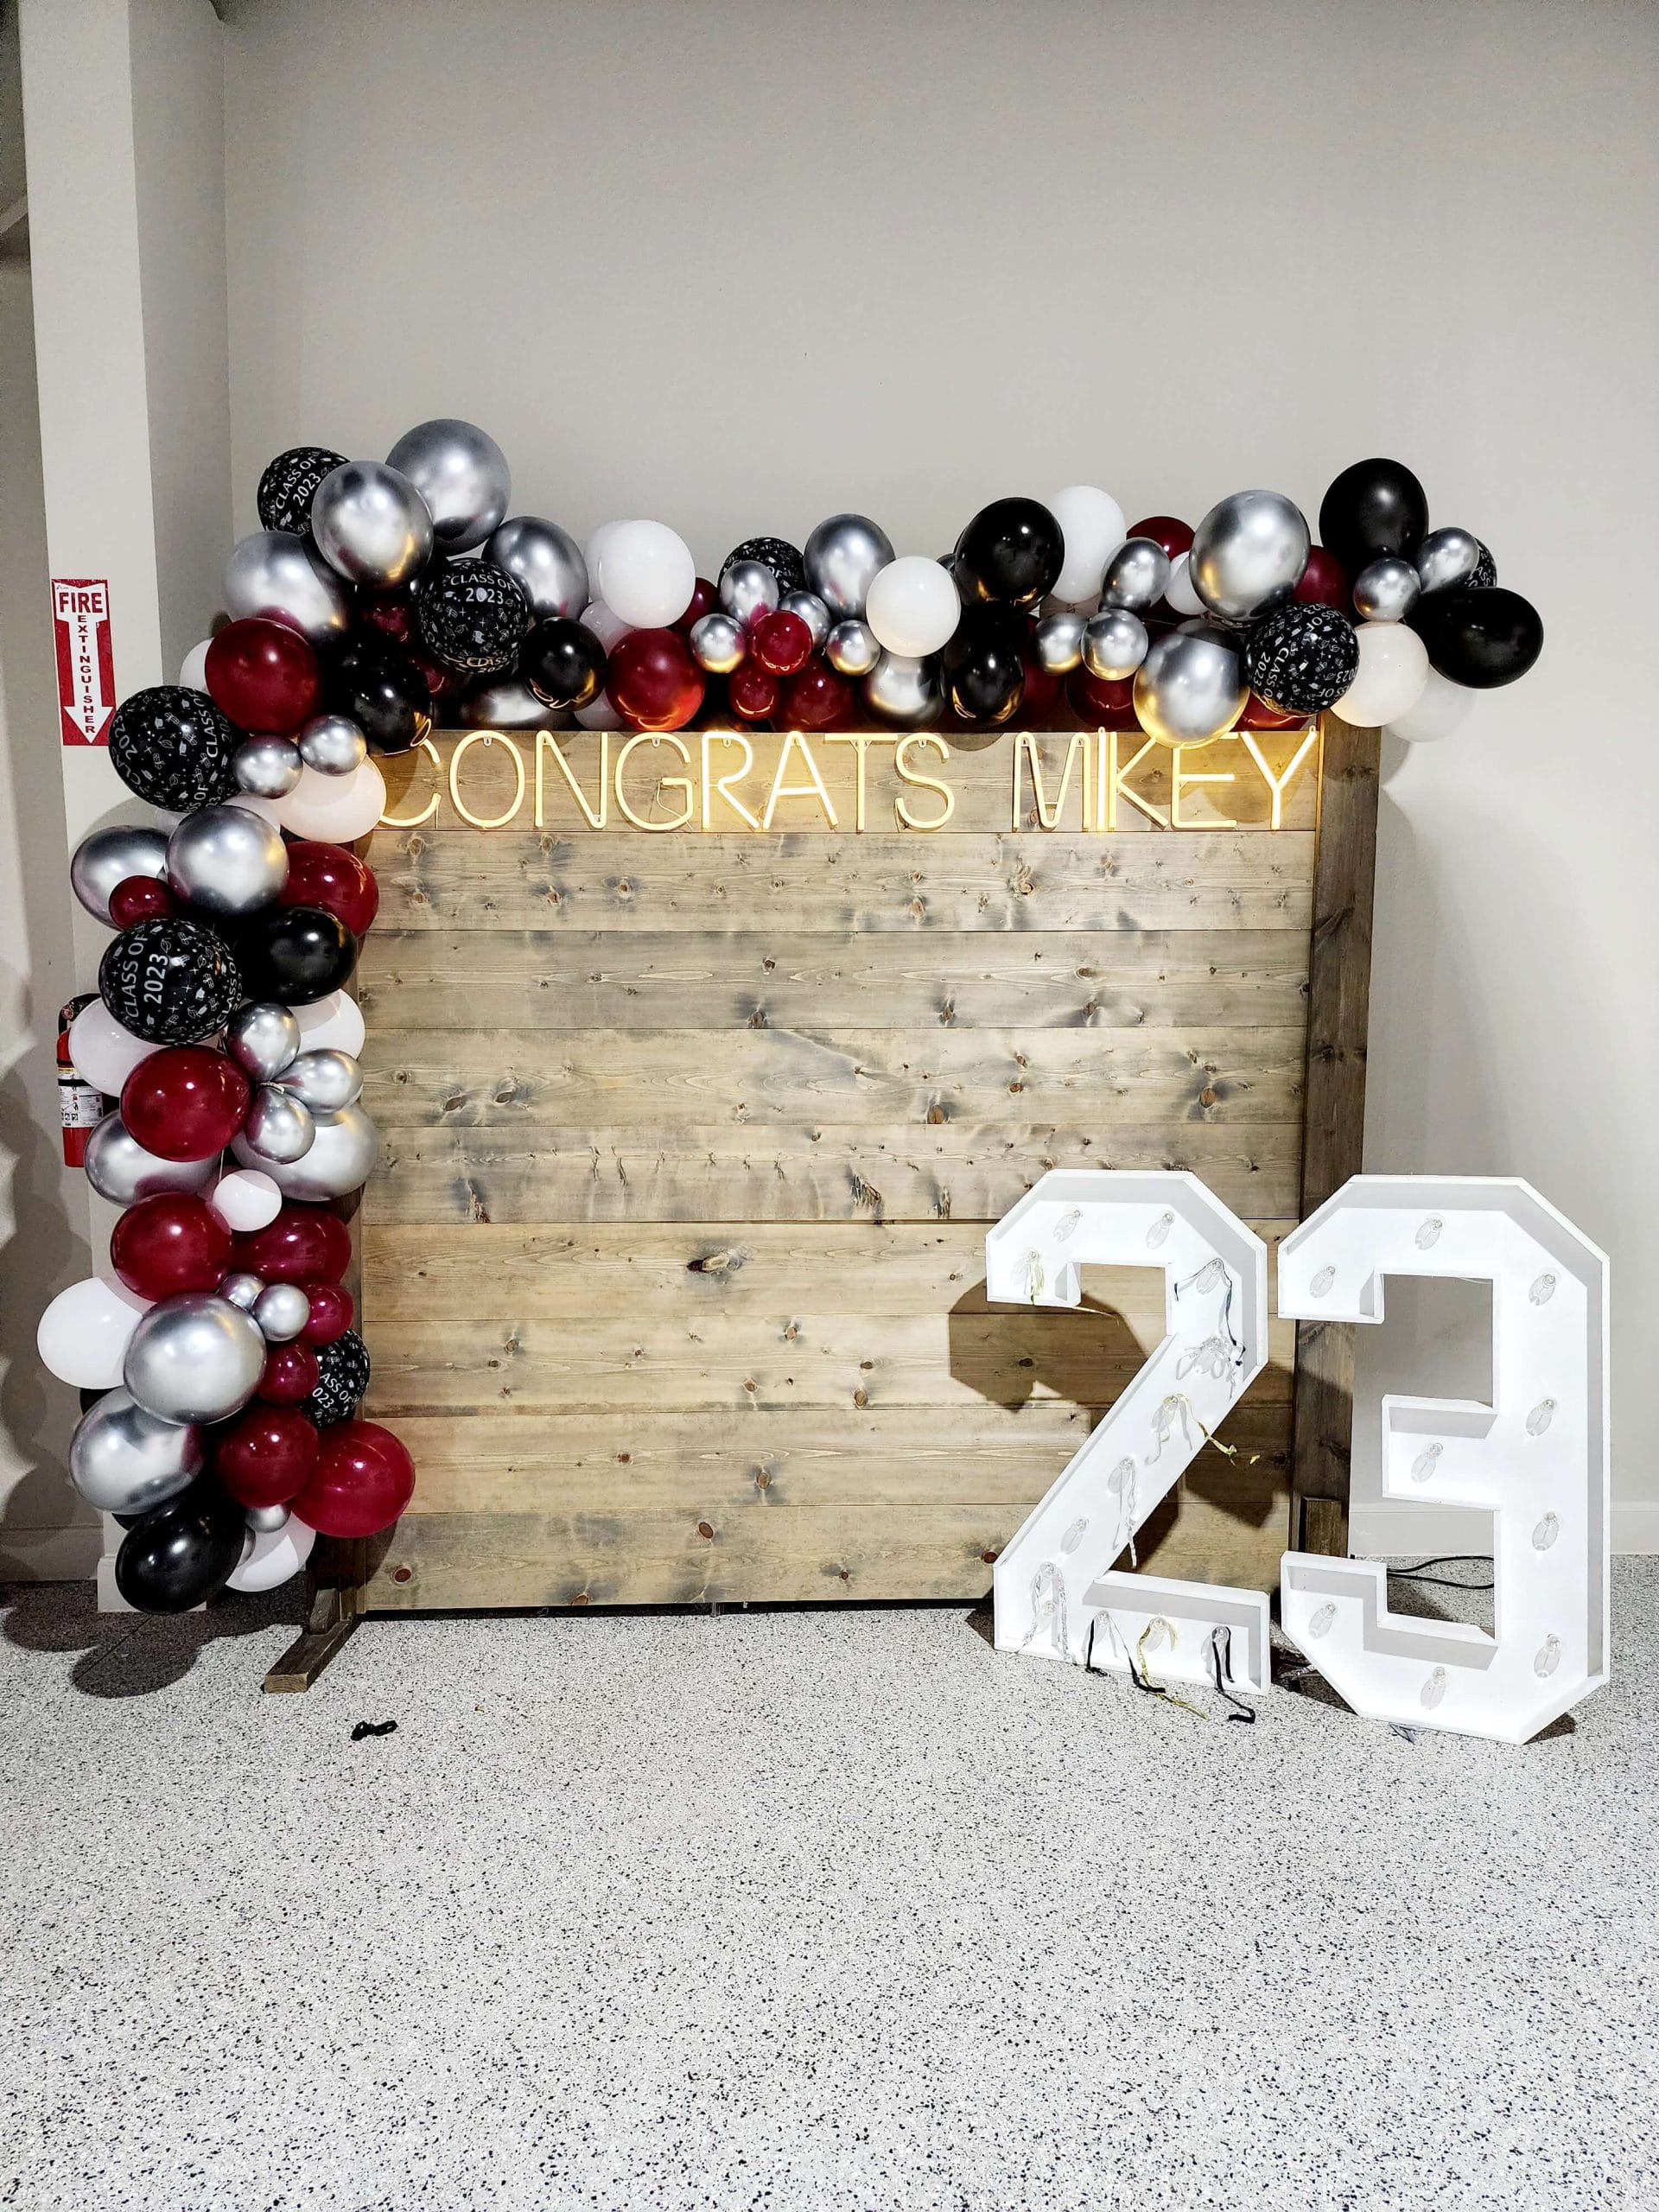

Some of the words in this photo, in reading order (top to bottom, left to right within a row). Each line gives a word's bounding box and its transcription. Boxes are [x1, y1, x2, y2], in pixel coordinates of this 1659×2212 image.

[275, 468, 302, 509] CLASS
[299, 456, 317, 470] OF
[293, 472, 321, 507] 2023
[450, 574, 495, 586] CLASS
[466, 588, 504, 605] 2023
[59, 592, 103, 613] FIRE
[78, 614, 96, 734] EXTINGUISHER
[1253, 652, 1271, 687] 2023
[1266, 647, 1289, 688] CLASS
[199, 709, 219, 759] CLASS
[379, 730, 954, 831] CONGRATS
[1012, 726, 1318, 831] MIKEY
[127, 934, 149, 956] OF
[121, 960, 139, 1018] CLASS
[143, 954, 169, 1005] 2023
[312, 1387, 334, 1408] 023
[319, 1372, 342, 1393] ASS
[339, 1390, 353, 1404] OF
